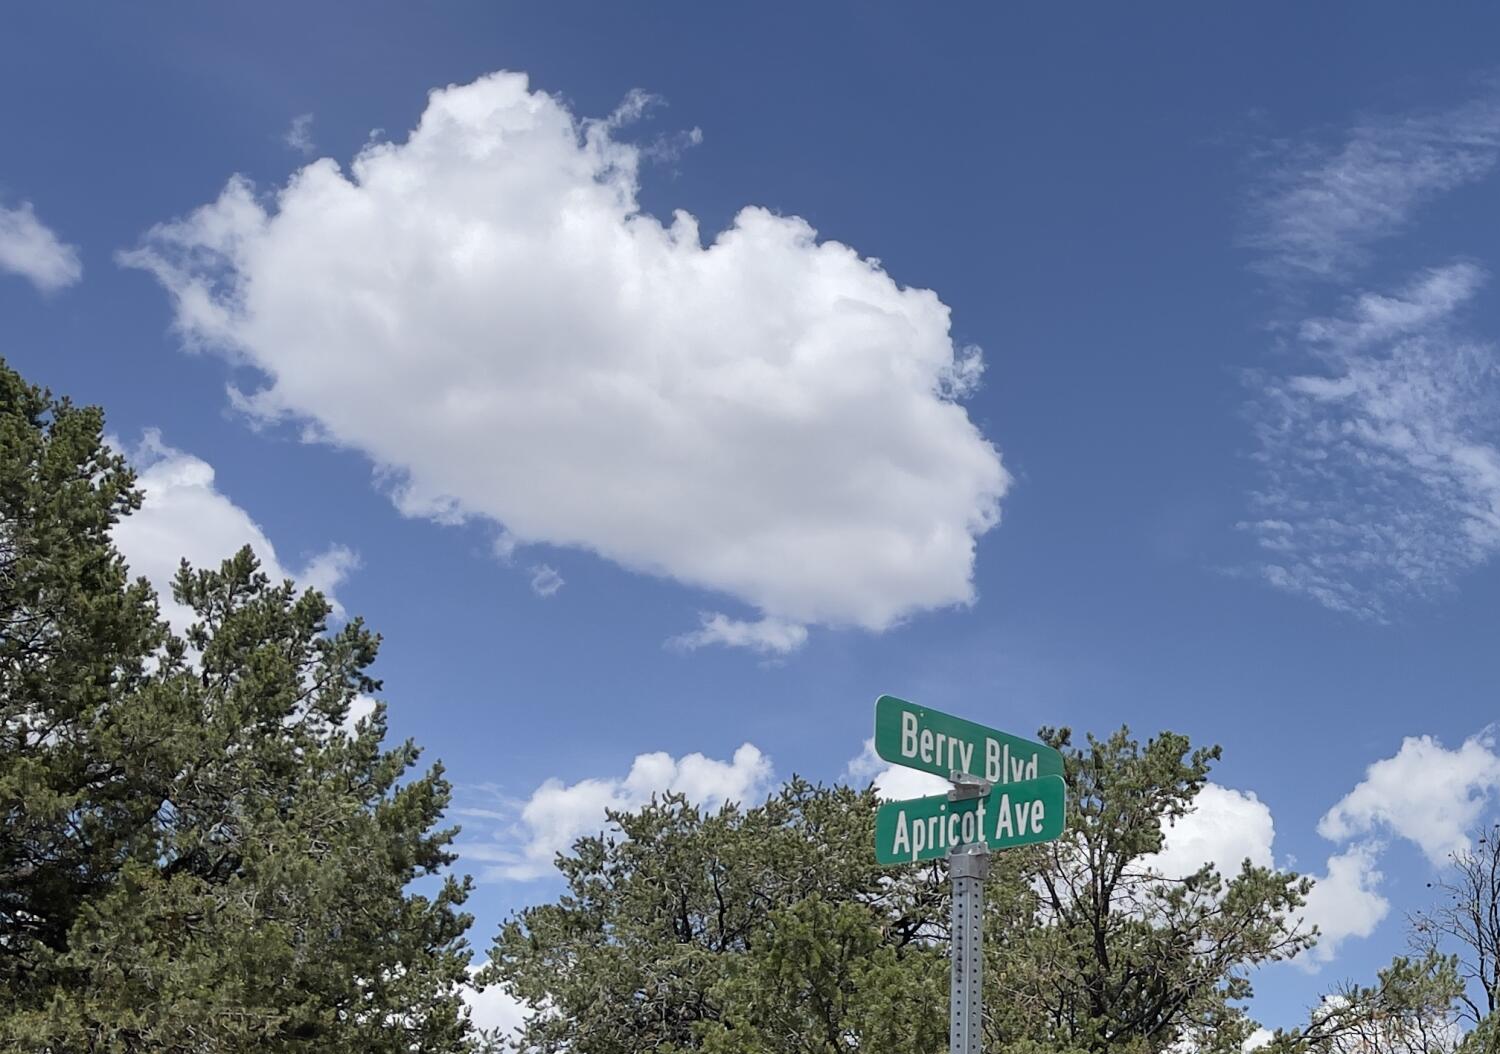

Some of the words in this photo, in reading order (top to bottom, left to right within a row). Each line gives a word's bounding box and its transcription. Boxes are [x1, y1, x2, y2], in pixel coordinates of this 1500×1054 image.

[901, 711, 974, 774] Berry
[985, 737, 1038, 784] Blvd
[892, 798, 986, 862] Apricot
[995, 794, 1045, 839] Ave
